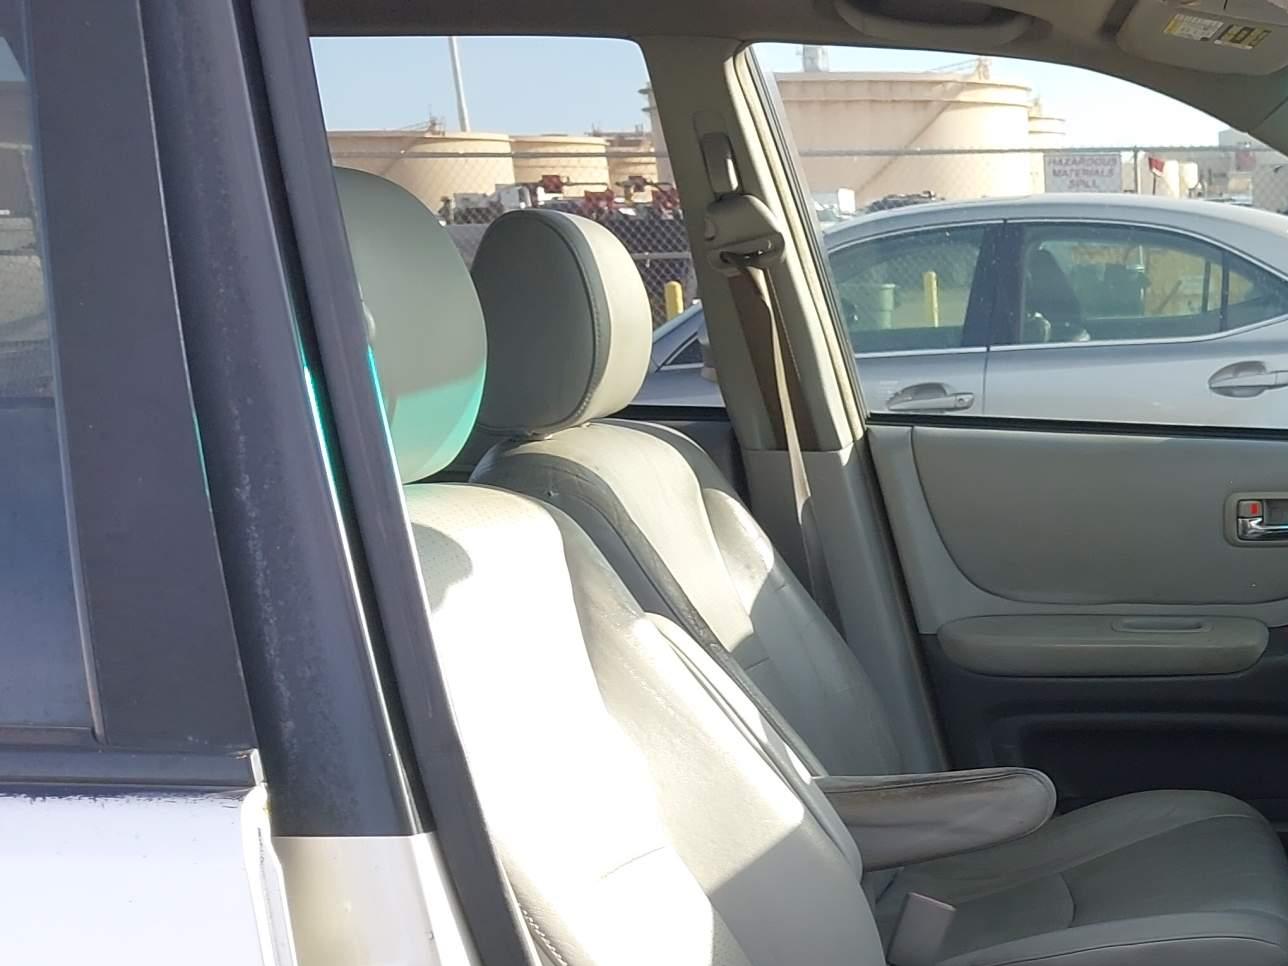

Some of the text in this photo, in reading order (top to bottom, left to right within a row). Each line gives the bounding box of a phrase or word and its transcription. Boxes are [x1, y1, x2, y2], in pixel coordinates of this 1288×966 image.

[1047, 157, 1118, 167] HAZARDOUS
[1052, 168, 1114, 177] MATERIALS
[1068, 179, 1100, 189] SPILL
